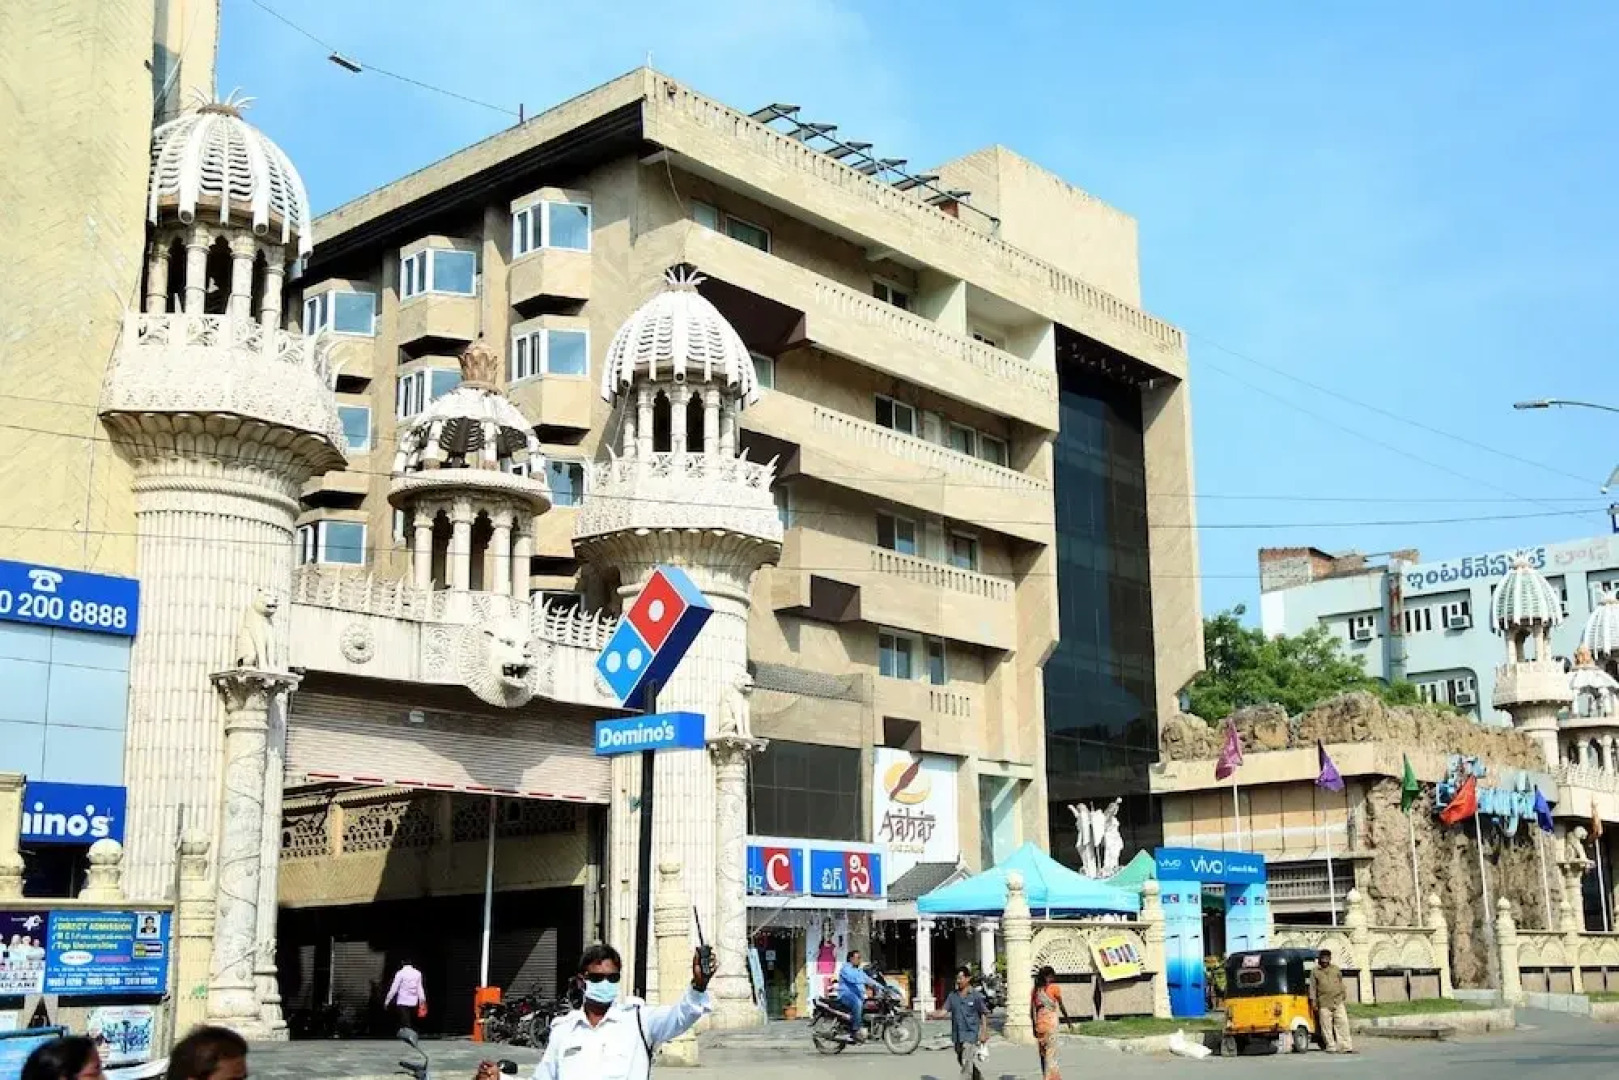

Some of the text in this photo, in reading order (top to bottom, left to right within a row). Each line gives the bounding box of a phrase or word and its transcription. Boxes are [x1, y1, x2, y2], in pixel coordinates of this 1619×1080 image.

[18, 592, 64, 620] 200
[69, 600, 127, 629] 8888
[599, 719, 675, 748] Domino's
[878, 808, 936, 843] Aahar
